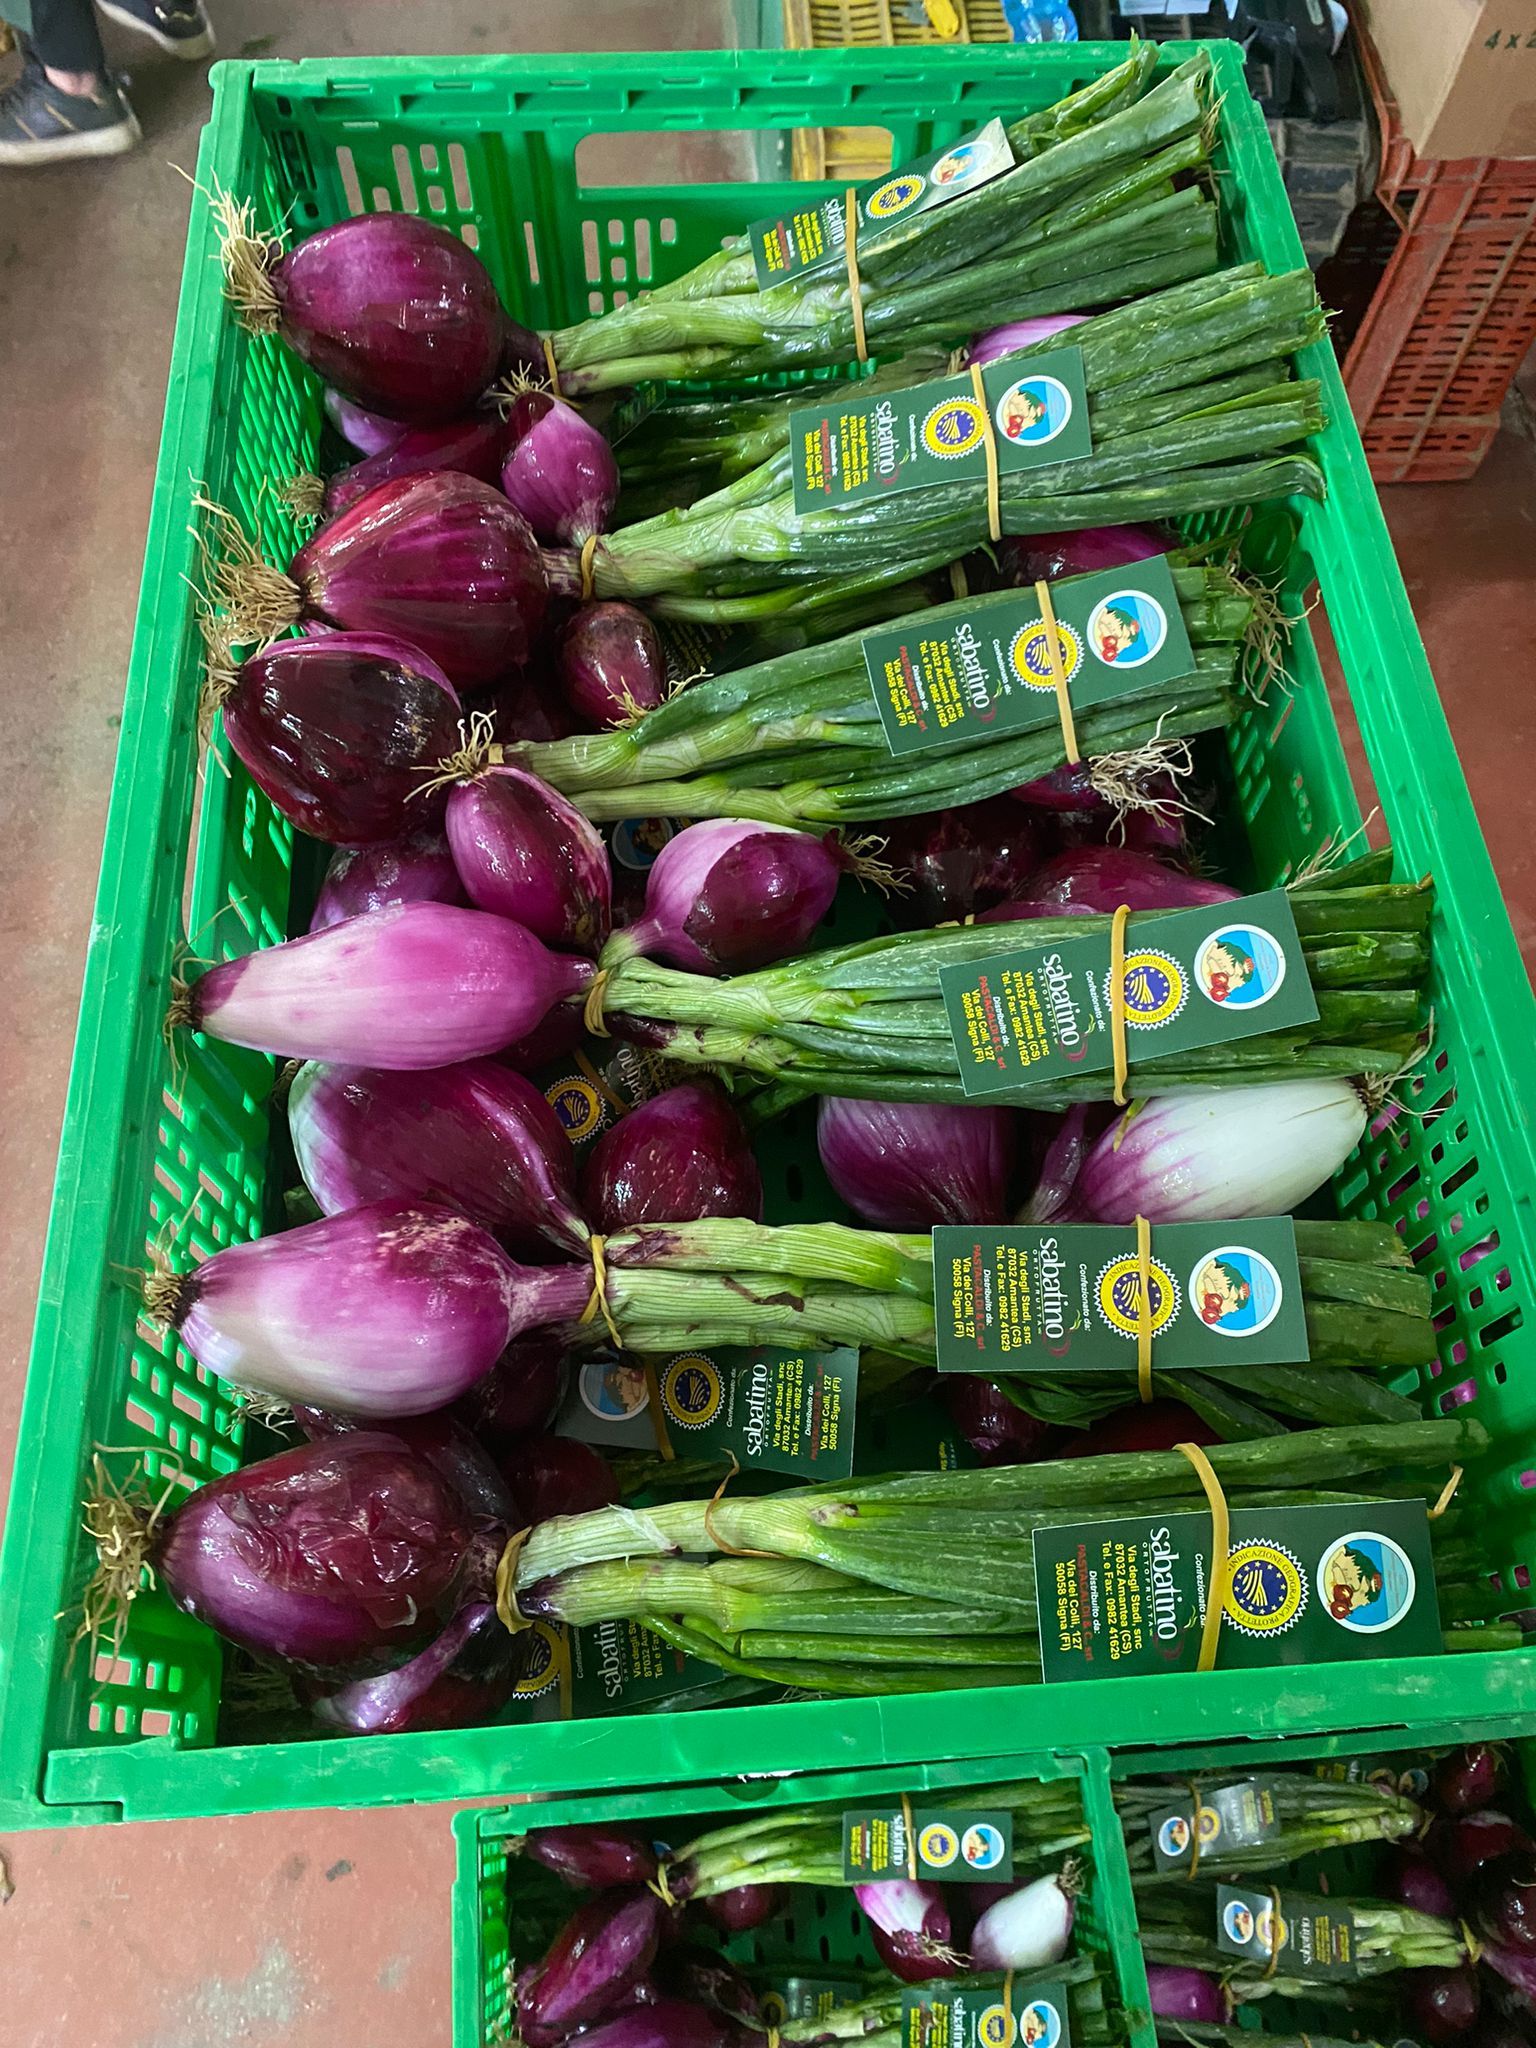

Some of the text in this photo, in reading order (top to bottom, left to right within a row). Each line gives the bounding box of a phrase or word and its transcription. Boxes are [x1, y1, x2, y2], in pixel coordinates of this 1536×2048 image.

[875, 401, 900, 474] sabatino
[955, 624, 990, 708] sabatino
[992, 996, 1007, 1034] Distribuito
[1001, 970, 1012, 987] Tel.
[1006, 995, 1017, 1016] Fax:
[1024, 971, 1050, 1056] Via degli Stadi, snc
[1043, 954, 1081, 1045] sabatino
[1085, 970, 1102, 1019] Confezionato
[961, 992, 985, 1063] 50058 Signa (FI)
[971, 988, 996, 1061] Via dei Colli, 127
[1011, 1016, 1024, 1039] 0982
[1012, 971, 1041, 1061] 87032 Amantea (CS)
[1017, 1039, 1031, 1066] 41629
[996, 1244, 1006, 1262] Tel.
[997, 1272, 1007, 1294] Fax:
[1040, 1238, 1068, 1338] sabatino
[952, 1258, 965, 1338] 50058 Signa (FI)
[962, 1257, 975, 1338] Via dei Colli, 127
[983, 1269, 994, 1327] Distribuito da:
[998, 1295, 1009, 1320] 0982
[1007, 1248, 1022, 1348] 87032 Amantea (CS)
[1018, 1250, 1032, 1345] Via degli Stadi, snc
[1079, 1263, 1092, 1332] Confezionato da:
[1000, 1321, 1011, 1352] 41629
[743, 1364, 767, 1456] sabatino
[774, 1408, 784, 1431] degli
[775, 1381, 785, 1407] Stadi,
[781, 1360, 796, 1452] 87032 Amantea (CS)
[790, 1358, 804, 1456] Tel. e Fax: 0982 41629
[804, 1396, 814, 1436] Distribuito
[820, 1374, 832, 1450] Via dei Colli, 127
[828, 1376, 842, 1450] 50058 Signa (FI)
[772, 1432, 781, 1447] Via
[1055, 1562, 1071, 1651] 50058 Signa (FI)
[1066, 1559, 1083, 1650] Via dei Colli, 127
[1089, 1570, 1101, 1634] Distribuito da:
[1102, 1540, 1120, 1660] Tel. e Fax: 0982 41629
[1114, 1543, 1132, 1654] 87032 Amantea (CS)
[1127, 1544, 1143, 1650] Via degli Stadi, snc
[1150, 1527, 1183, 1639] sabatino
[1195, 1553, 1209, 1613] Confezionato
[1229, 1549, 1297, 1627] INDICAZIONE GEOGRAFICA PROTETTA
